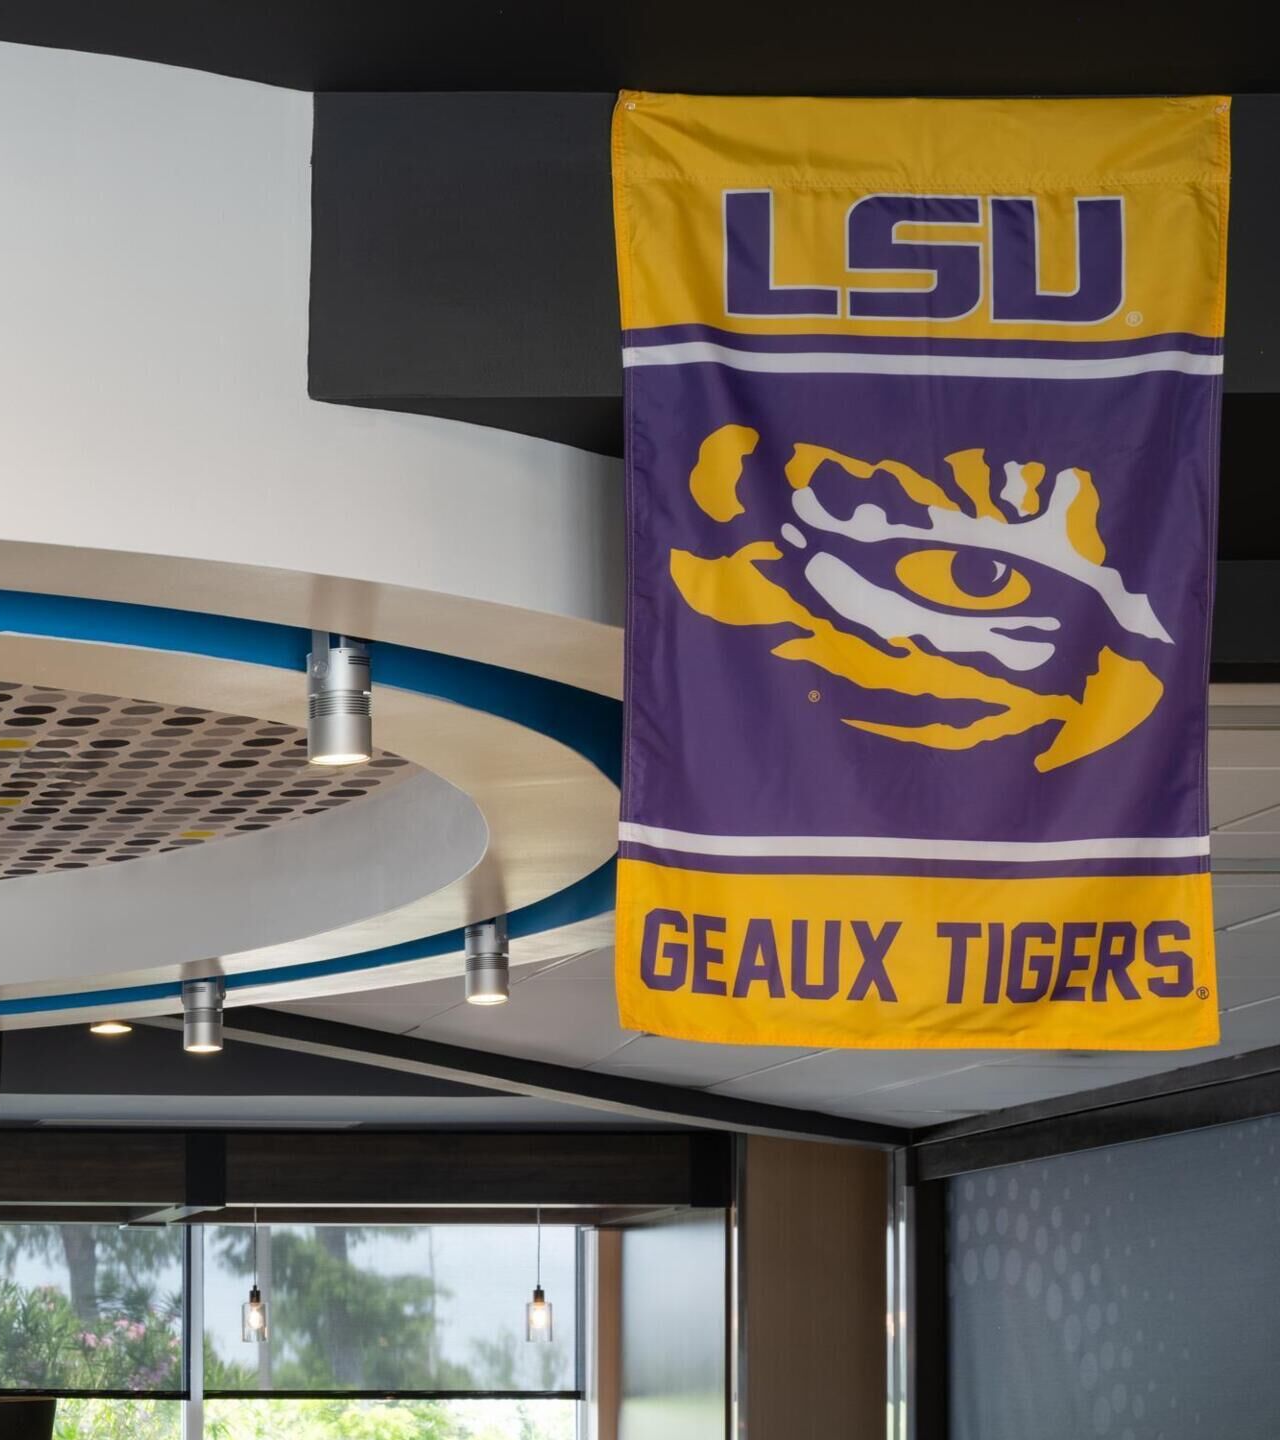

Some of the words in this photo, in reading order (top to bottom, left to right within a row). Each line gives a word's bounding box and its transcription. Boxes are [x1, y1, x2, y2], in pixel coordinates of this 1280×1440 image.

[722, 189, 1125, 324] LSU
[639, 907, 903, 1003] GEAUX
[936, 920, 1194, 1006] TIGERS
